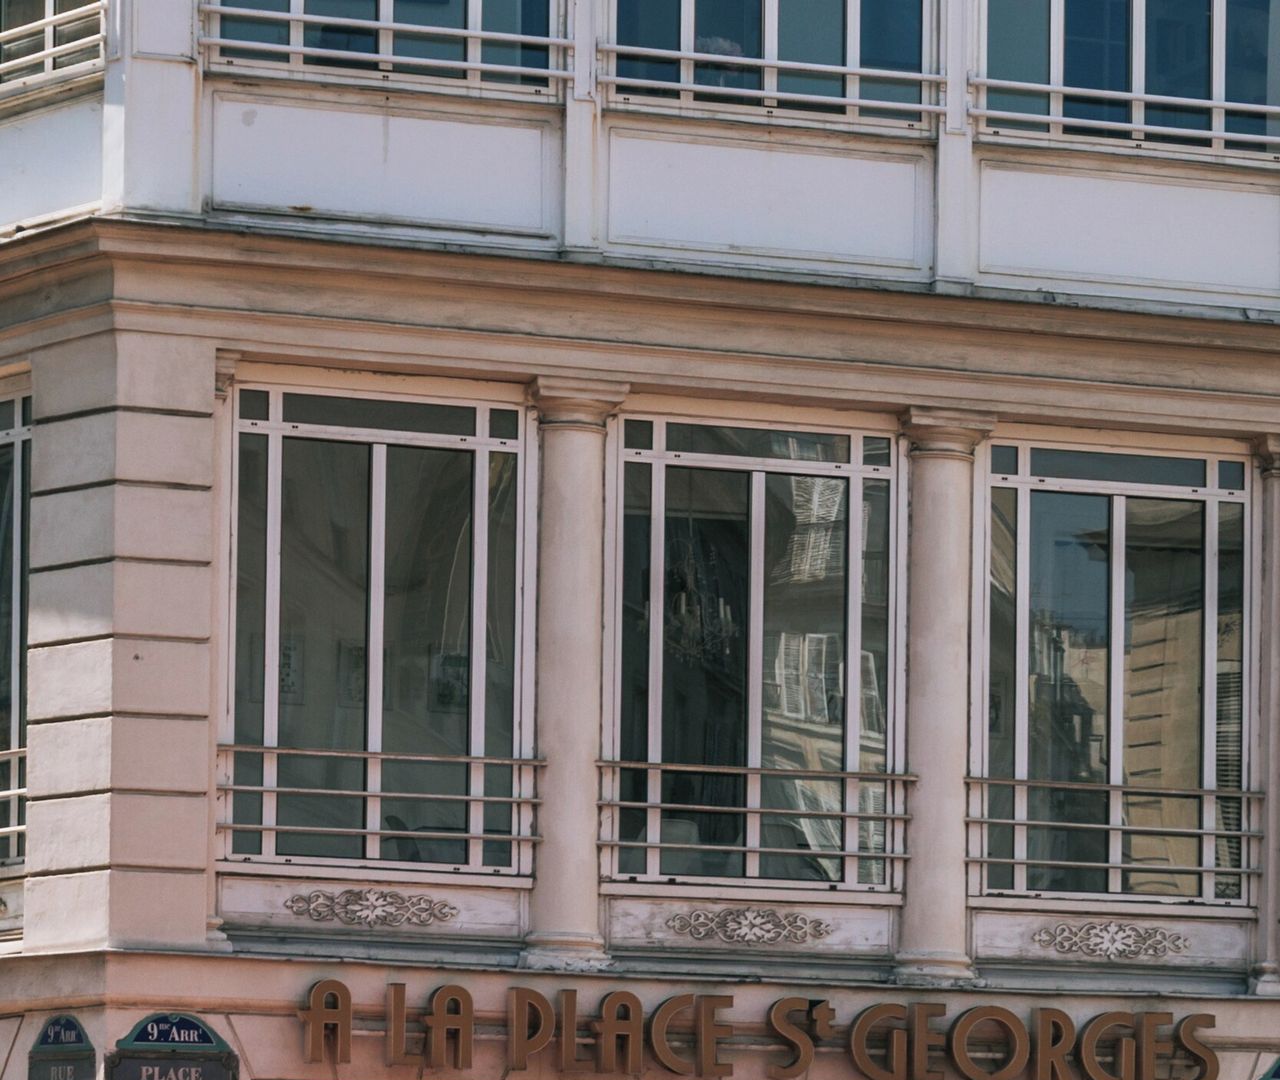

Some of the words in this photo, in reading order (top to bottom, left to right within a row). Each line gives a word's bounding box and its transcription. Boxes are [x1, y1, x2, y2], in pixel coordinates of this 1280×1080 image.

[298, 978, 352, 1063] A
[386, 982, 474, 1069] LA
[508, 986, 735, 1077] PLACE
[767, 996, 836, 1080] St
[50, 1066, 74, 1080] RUE
